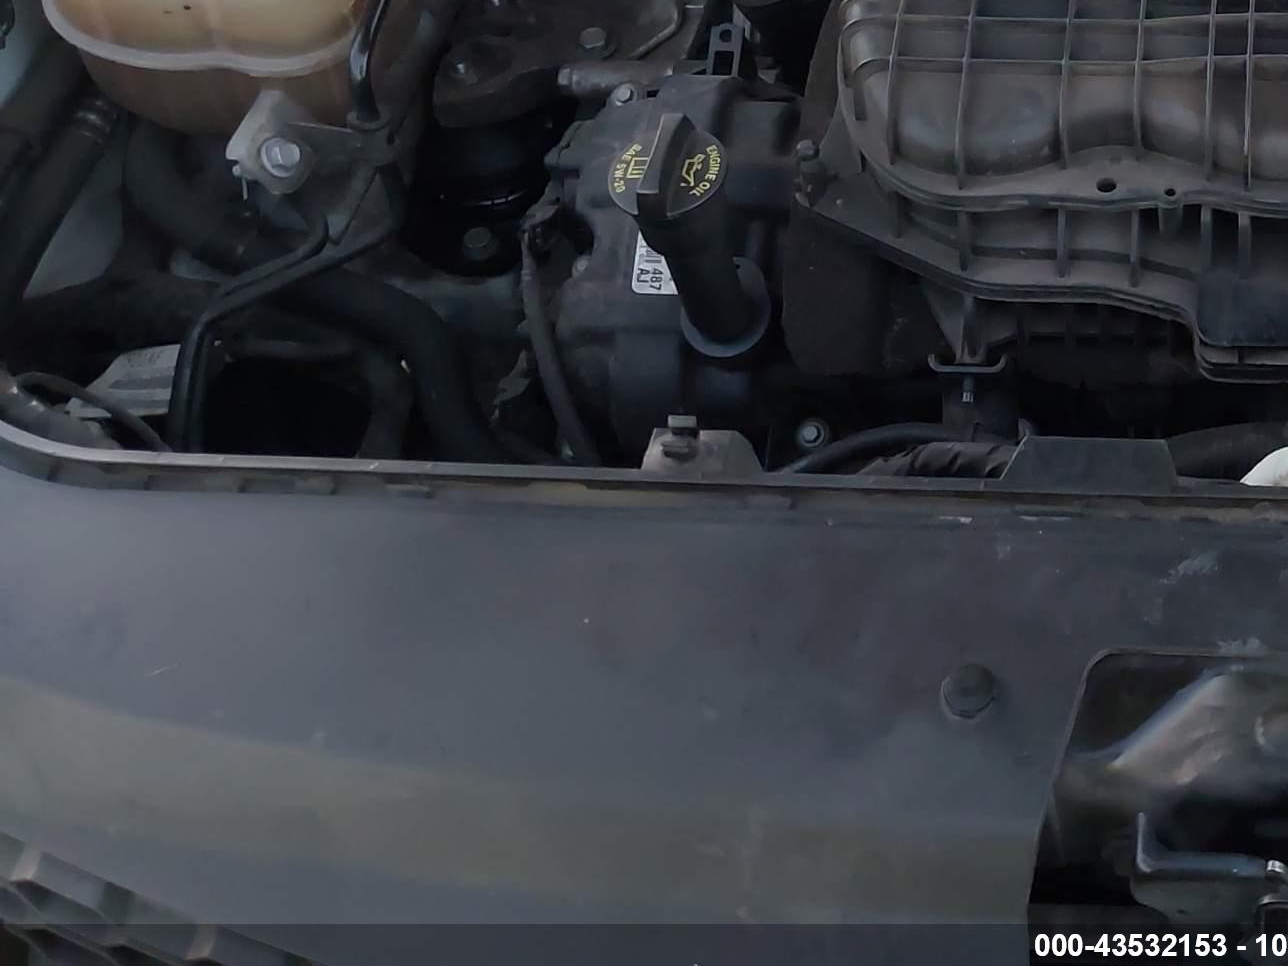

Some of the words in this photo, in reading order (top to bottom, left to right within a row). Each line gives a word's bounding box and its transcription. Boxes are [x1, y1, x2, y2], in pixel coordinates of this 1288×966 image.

[705, 144, 721, 181] ENGINE
[689, 181, 711, 197] OIL
[649, 267, 664, 291] 487
